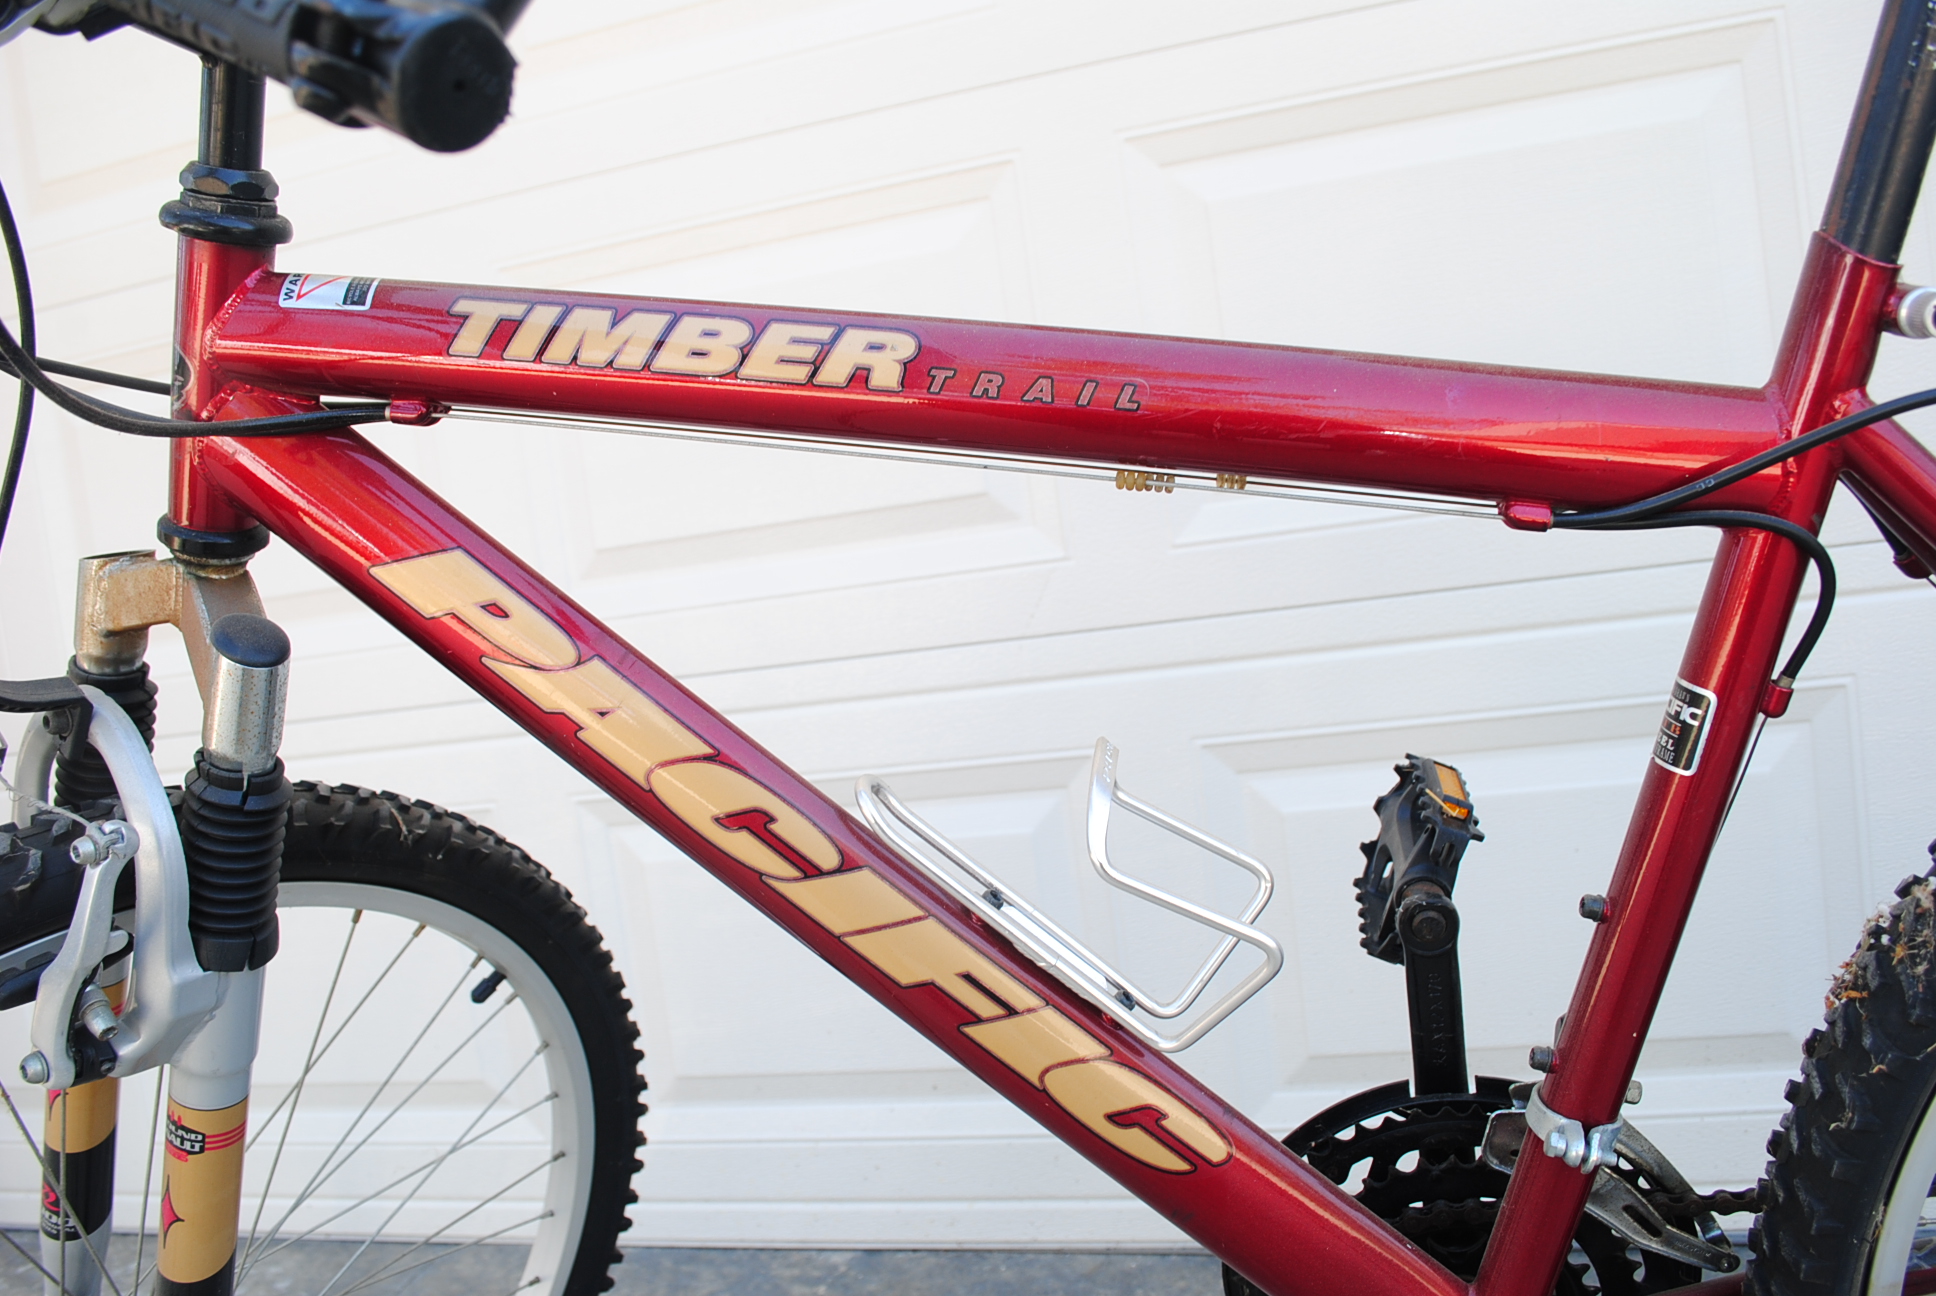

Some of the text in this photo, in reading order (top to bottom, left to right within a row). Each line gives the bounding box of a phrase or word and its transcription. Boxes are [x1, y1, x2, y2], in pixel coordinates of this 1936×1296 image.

[447, 296, 1141, 411] TIMBER TRAIL
[367, 547, 1235, 1174] PACIFIC
